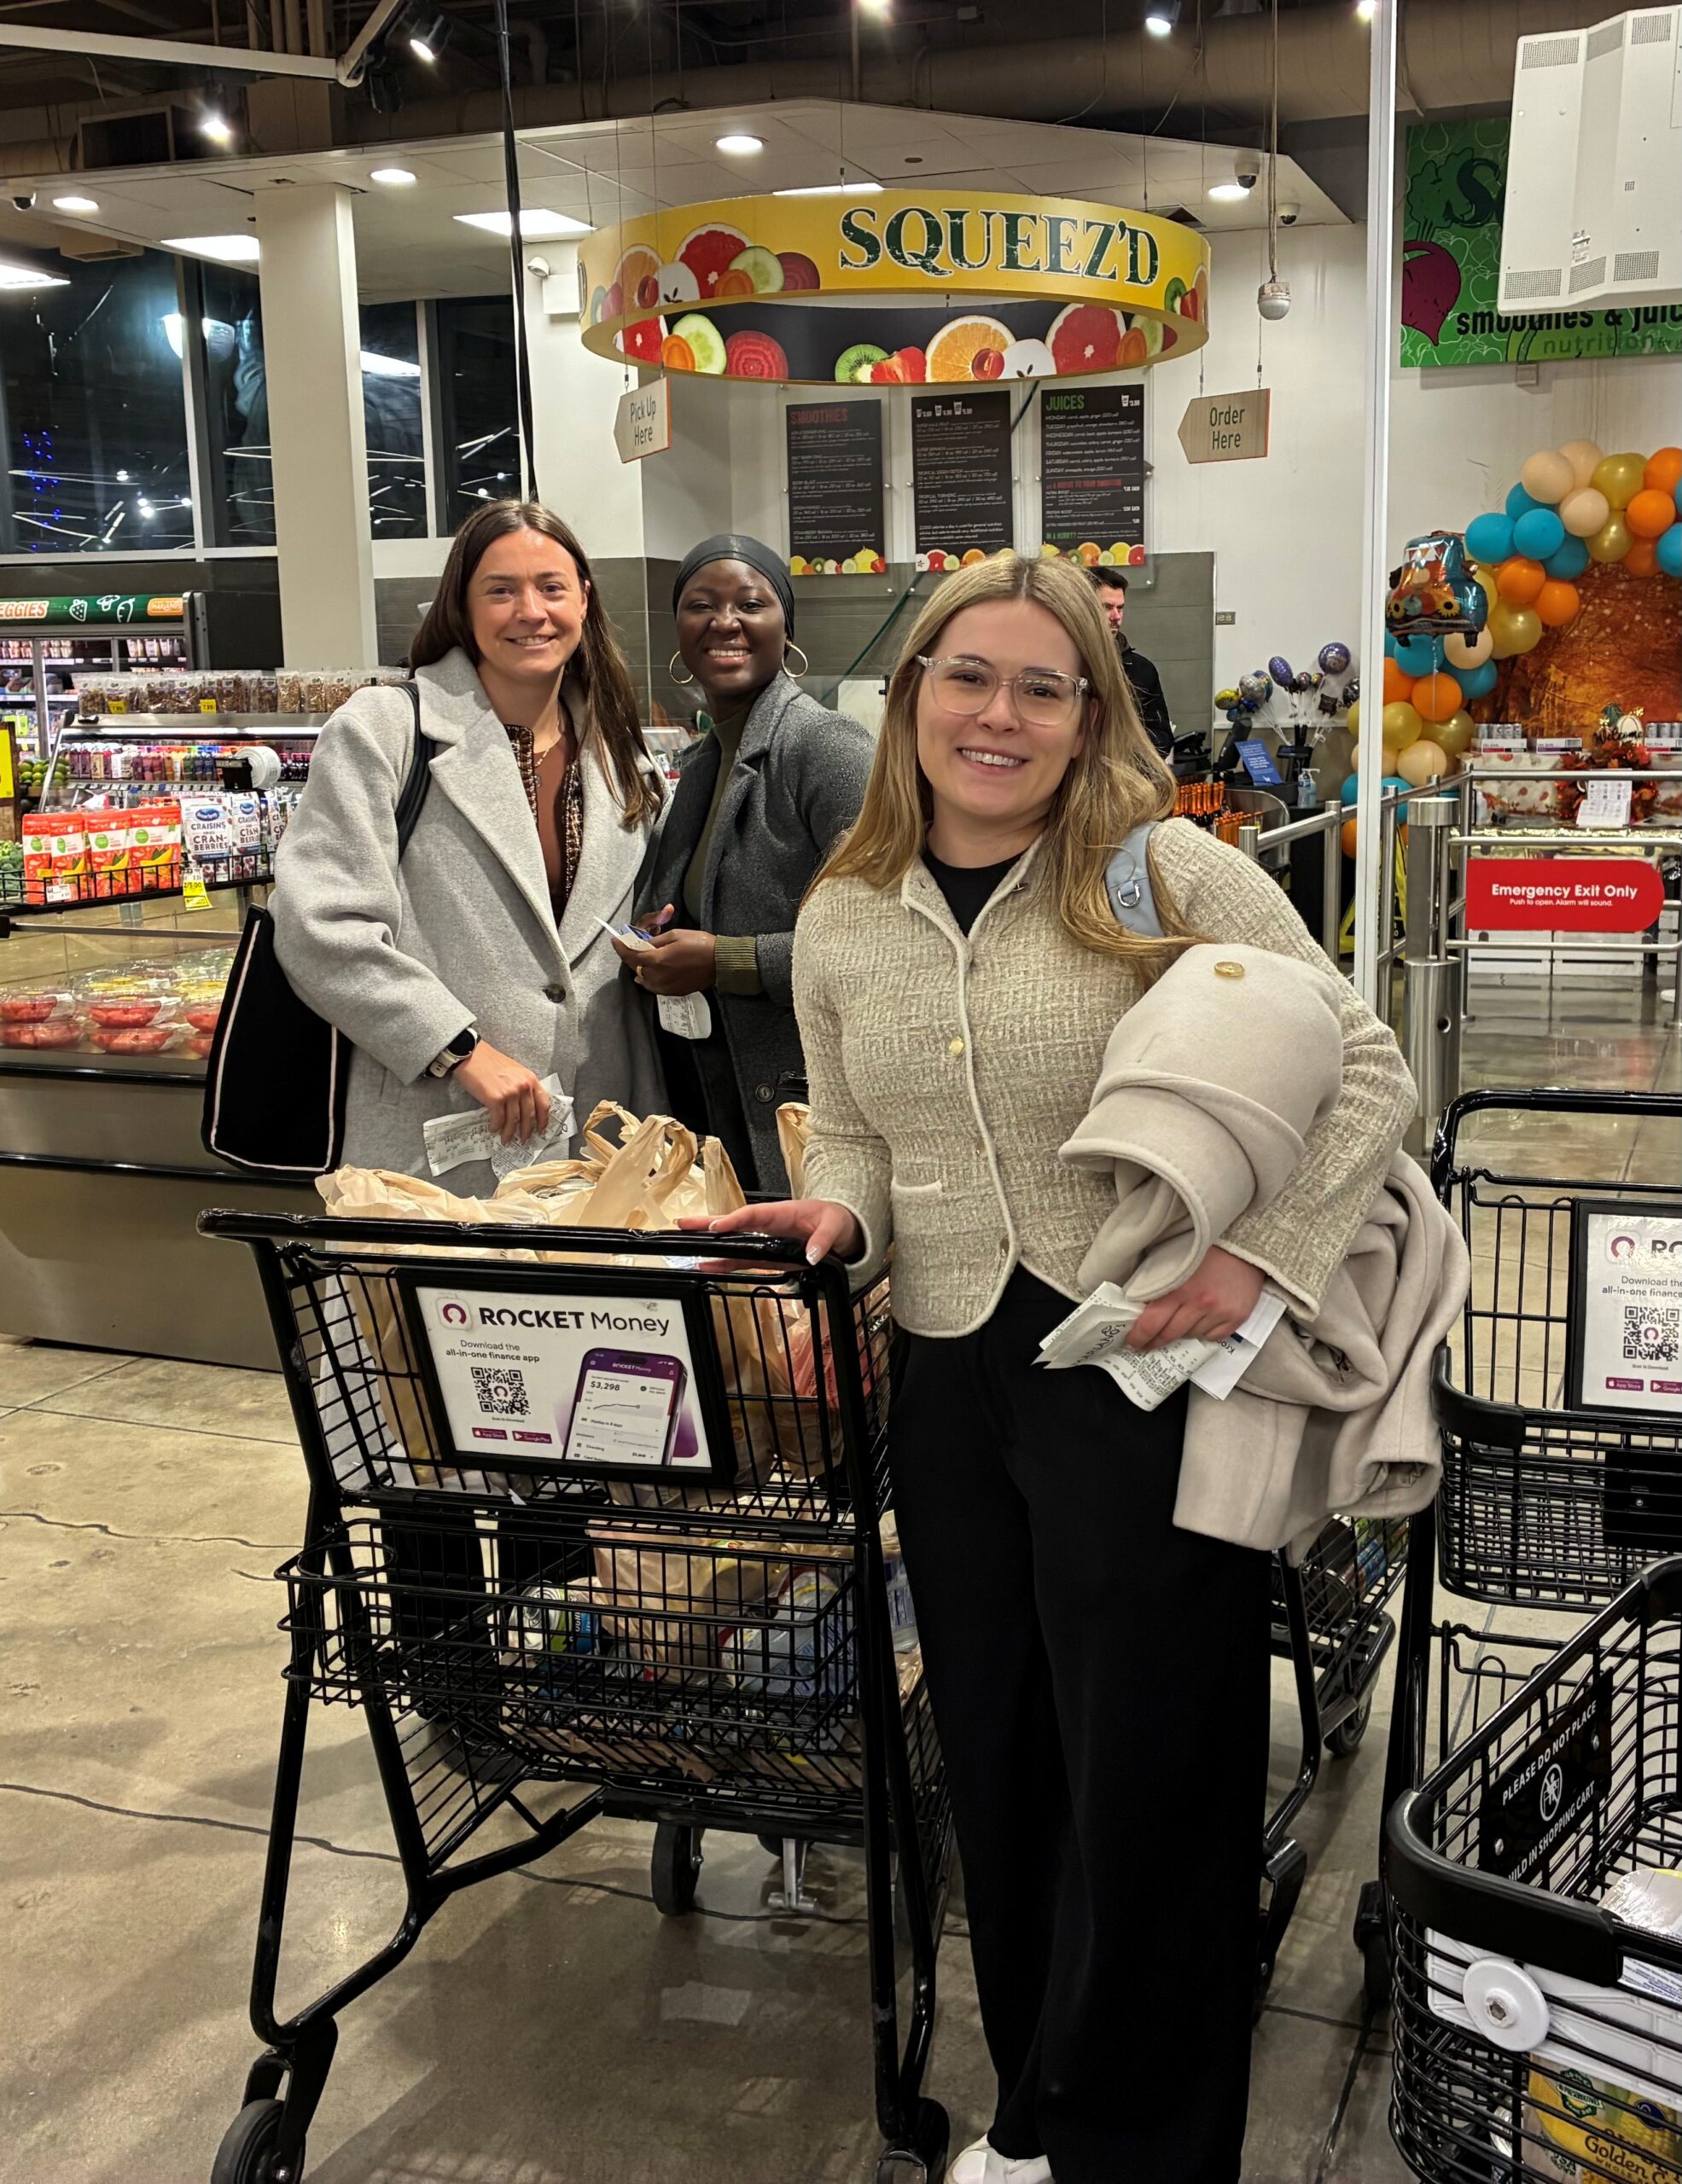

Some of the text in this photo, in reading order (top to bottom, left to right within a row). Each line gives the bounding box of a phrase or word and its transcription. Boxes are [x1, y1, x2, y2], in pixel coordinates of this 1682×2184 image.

[840, 207, 1160, 287] SQUEEZ'D
[630, 395, 656, 423] Pick Up
[1045, 394, 1085, 410] JUICES
[790, 408, 848, 425] SMOOTHIES
[1209, 404, 1245, 427] Order
[634, 425, 653, 446] Here
[1212, 430, 1241, 450] Here
[1592, 726, 1643, 745] Welcome
[190, 822, 226, 830] CRAISINS
[193, 834, 228, 844] CRAN-
[194, 842, 229, 851] BERRIES
[1492, 884, 1638, 899] Emergency Exit Only
[1621, 1275, 1667, 1286] Download
[1602, 1286, 1647, 1296] all-in-one
[479, 1307, 669, 1337] ROCKET Money
[460, 1339, 521, 1351] Download the
[445, 1349, 487, 1358] all-in-one
[489, 1352, 521, 1361] finance
[590, 1380, 620, 1391] $3,298
[1502, 1699, 1597, 1806] PLEASE DO NOT PLACE
[1508, 1780, 1595, 1882] HILD IN SHOPPING CART
[1585, 2135, 1649, 2179] Golden
